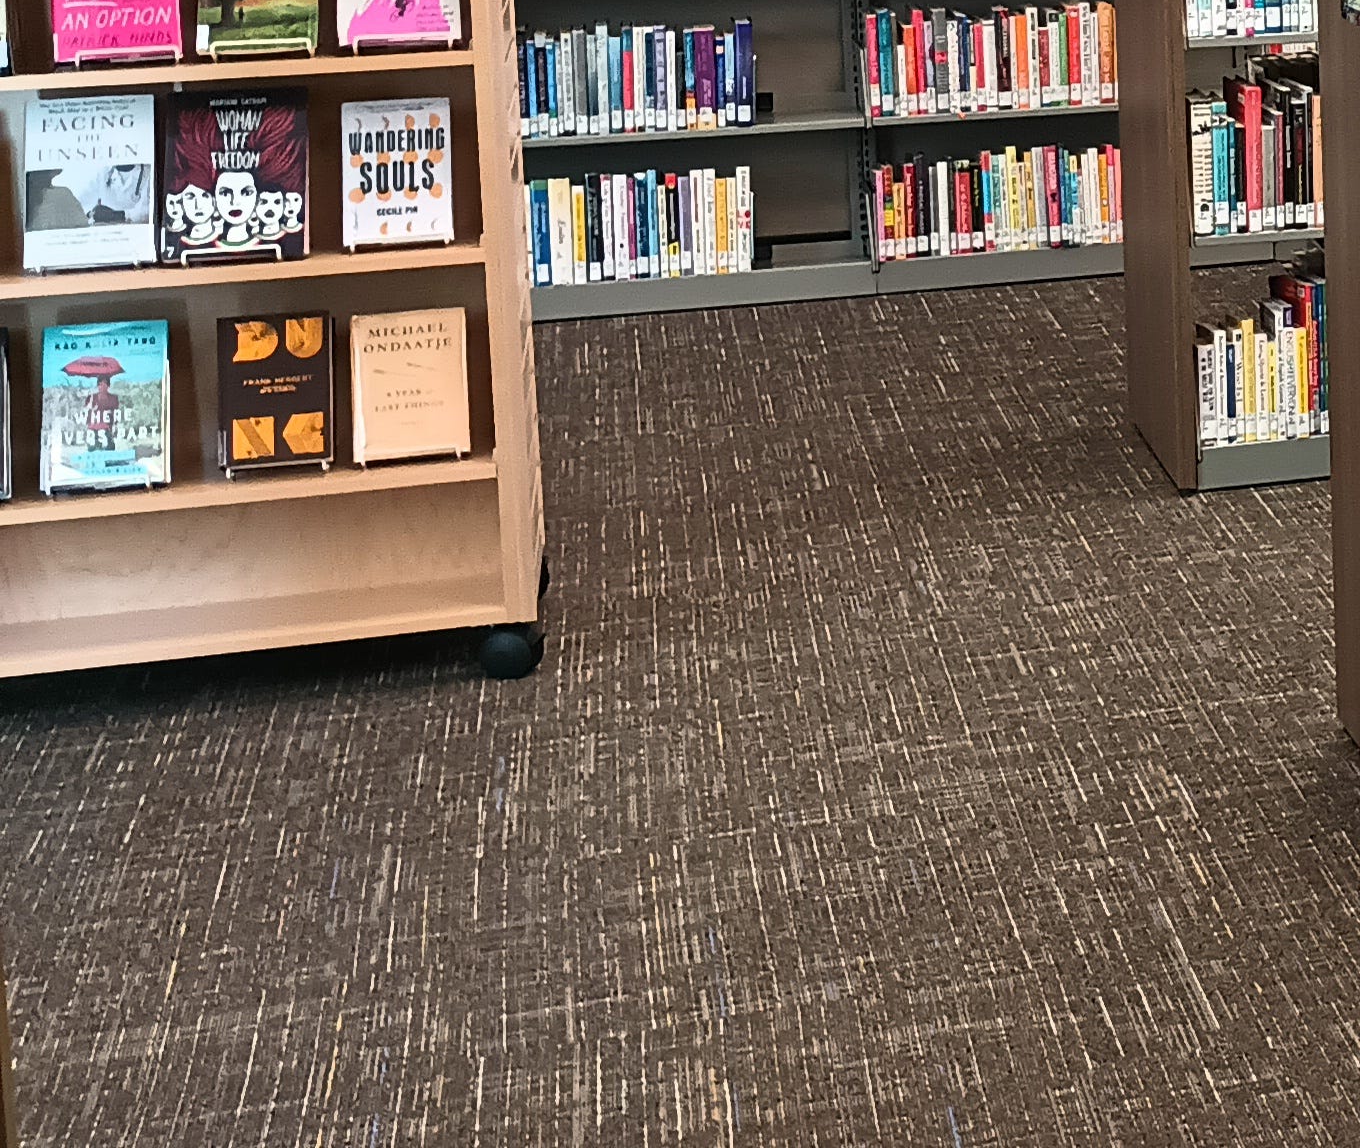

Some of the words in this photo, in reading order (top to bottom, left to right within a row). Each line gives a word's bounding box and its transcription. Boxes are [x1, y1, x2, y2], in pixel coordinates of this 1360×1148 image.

[61, 12, 89, 31] AN
[96, 6, 172, 26] OPTION
[41, 114, 135, 134] FACING
[216, 110, 263, 132] WOMAN
[223, 131, 250, 151] LIFE
[348, 127, 446, 156] WANDERING
[211, 151, 261, 170] FREEDOM
[359, 158, 436, 195] SOULS
[367, 322, 448, 338] MICHAEL
[363, 336, 453, 355] ONDAATJE
[74, 407, 134, 425] WHERE
